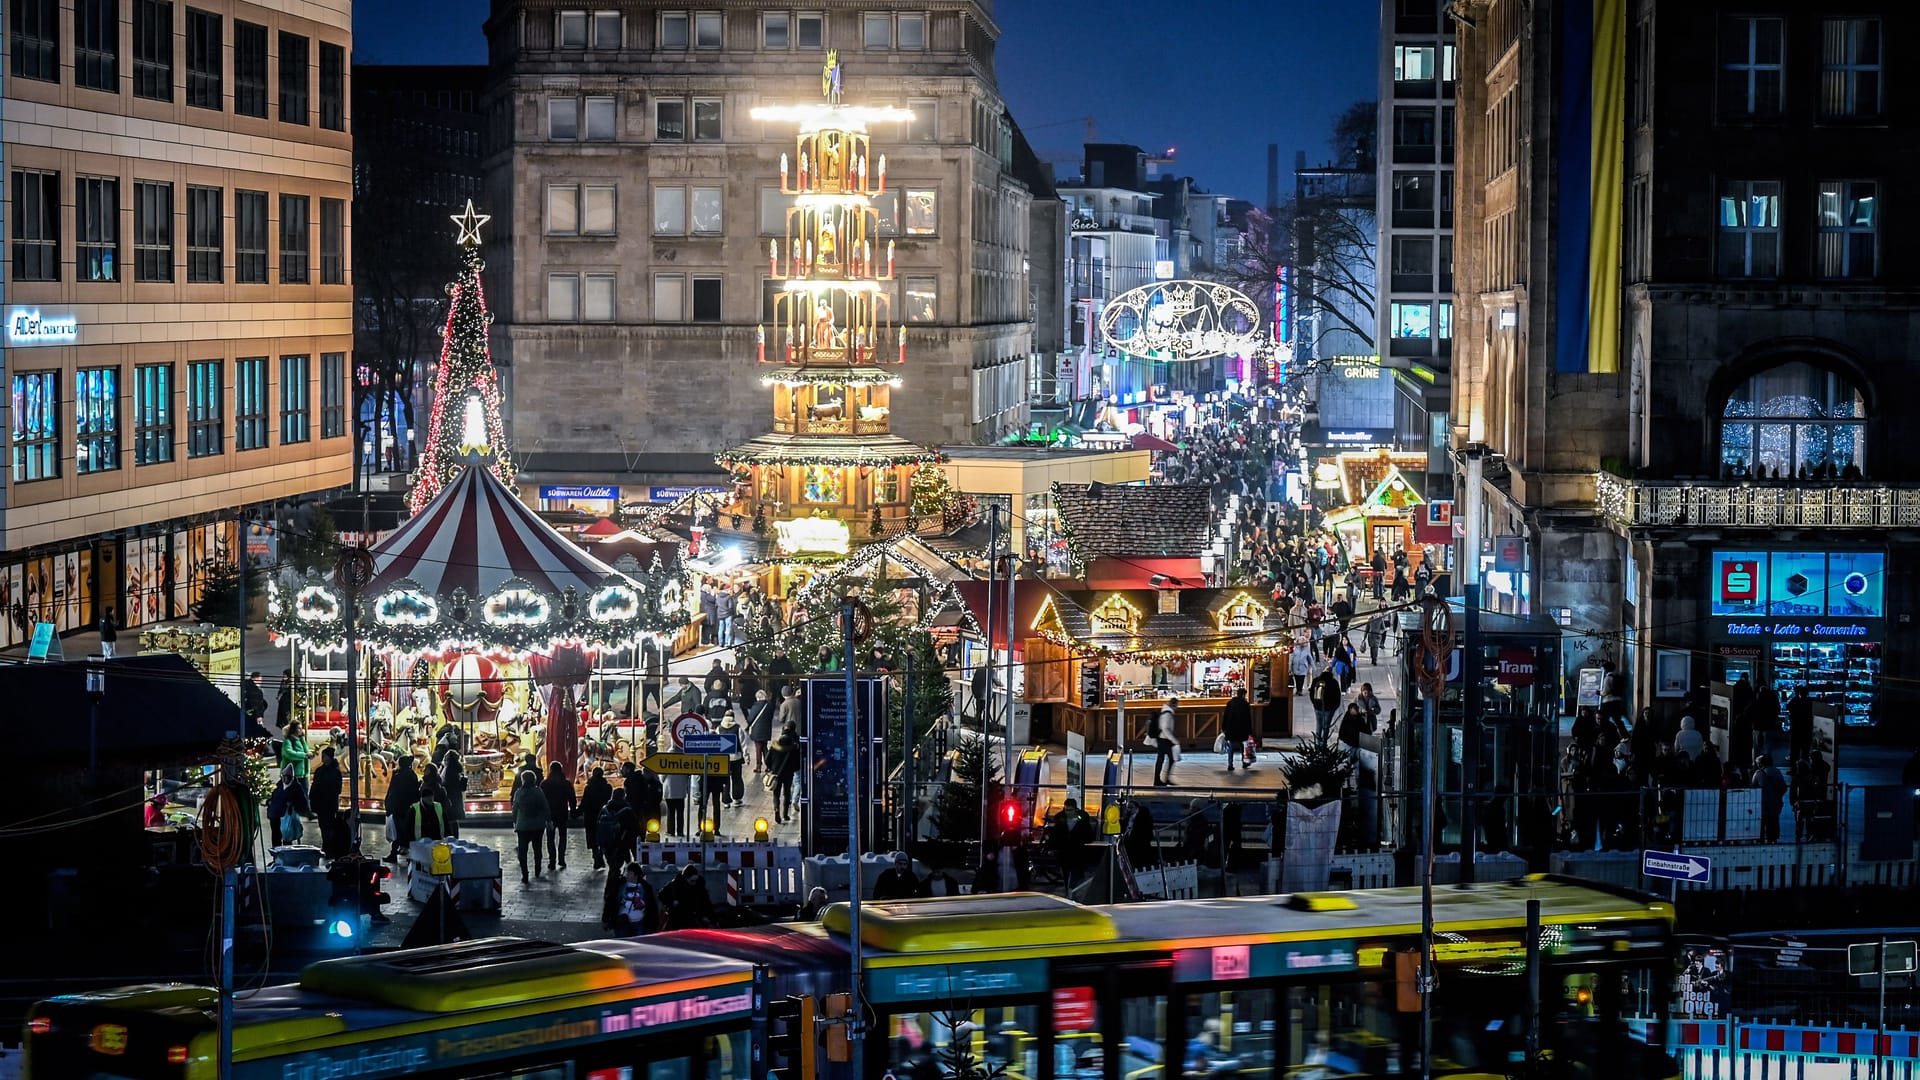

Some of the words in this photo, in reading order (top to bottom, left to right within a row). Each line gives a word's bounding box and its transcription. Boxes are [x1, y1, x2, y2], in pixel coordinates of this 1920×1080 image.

[1344, 366, 1380, 378] GRÜNE
[584, 486, 611, 497] Outlet
[1728, 624, 1762, 635] Tabak
[1773, 624, 1801, 635] Lotto
[1812, 624, 1866, 635] Souvenirs
[1720, 647, 1760, 655] SB-Service
[1500, 660, 1533, 673] Tram
[660, 758, 720, 772] Umleitung
[1648, 860, 1690, 871] Einbahnstraße
[1683, 991, 1710, 1001] need
[1680, 997, 1719, 1015] love!
[602, 1010, 629, 1034] im
